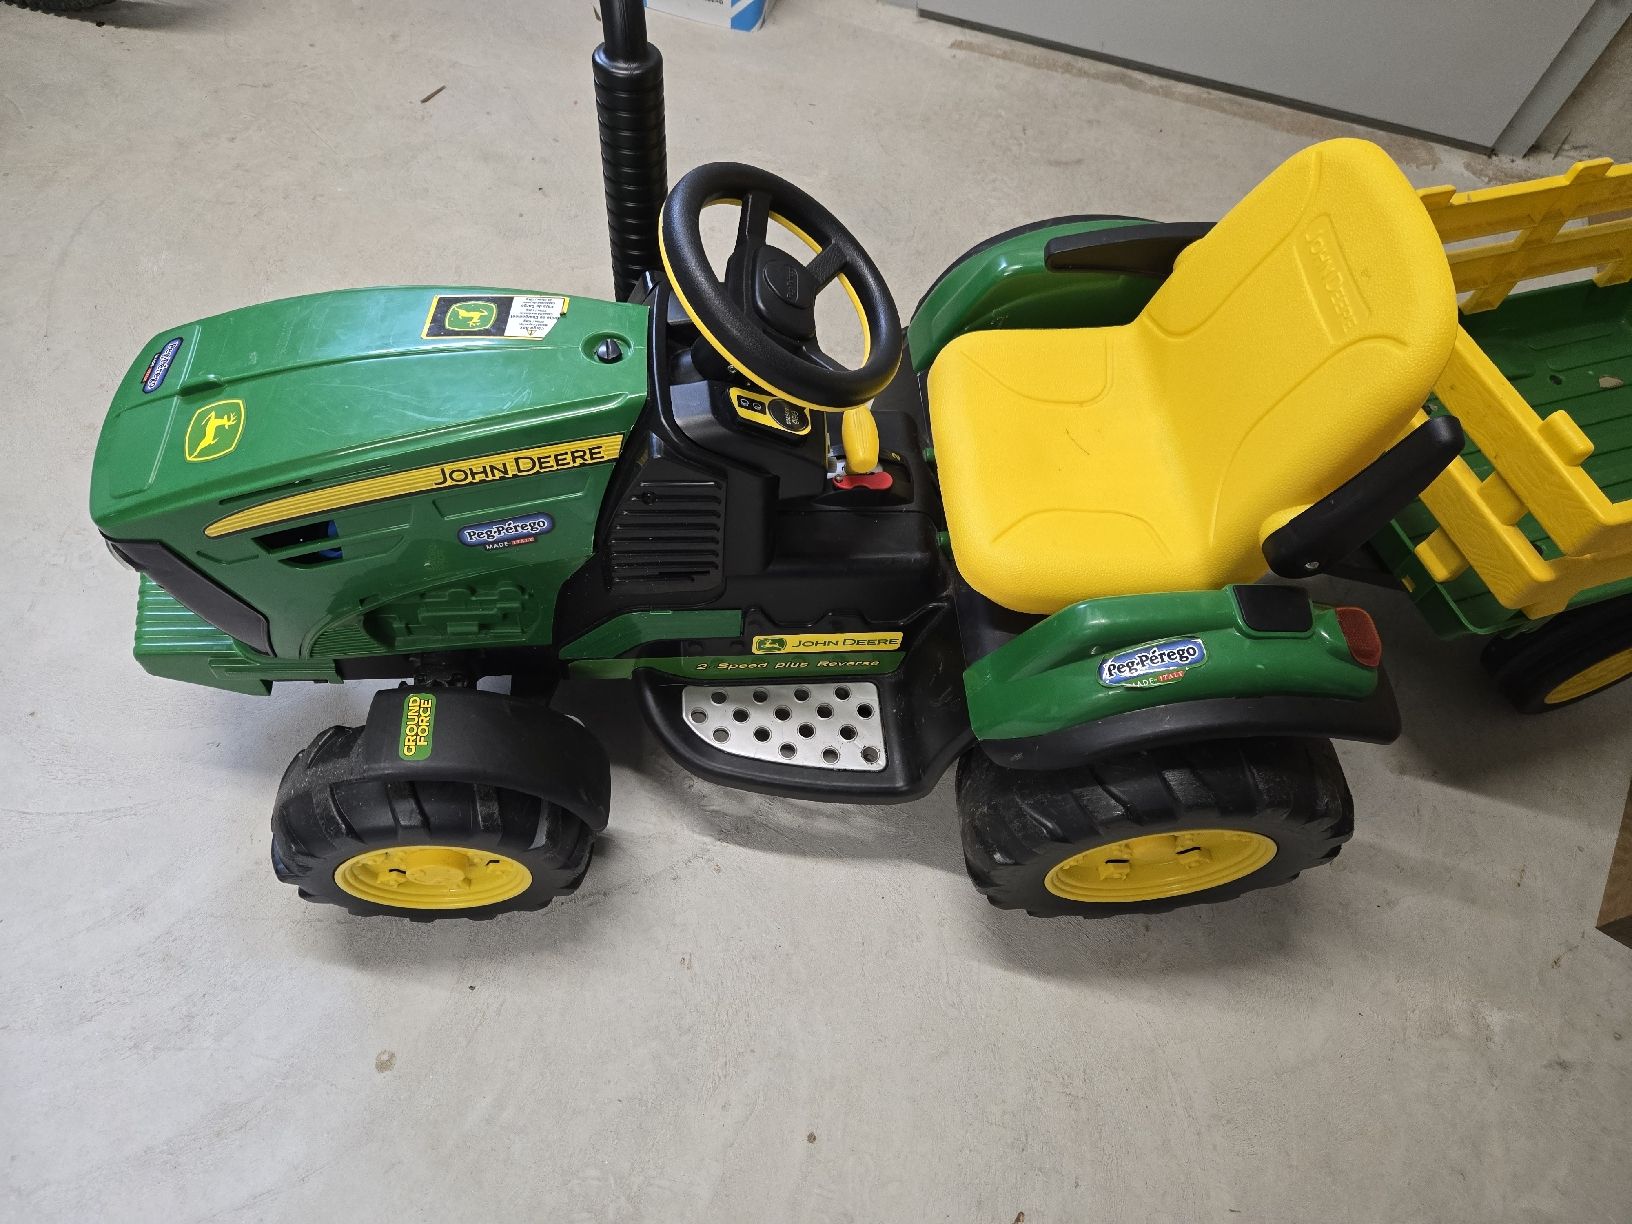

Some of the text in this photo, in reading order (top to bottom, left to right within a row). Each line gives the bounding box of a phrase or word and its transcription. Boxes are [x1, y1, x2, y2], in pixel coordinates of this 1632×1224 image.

[433, 445, 605, 486] JOHN DEERE
[792, 638, 900, 648] JOHN DEERE
[696, 660, 880, 670] 2 Speed plus Reverse
[403, 696, 420, 756] GROUND
[416, 699, 432, 746] FORCE
